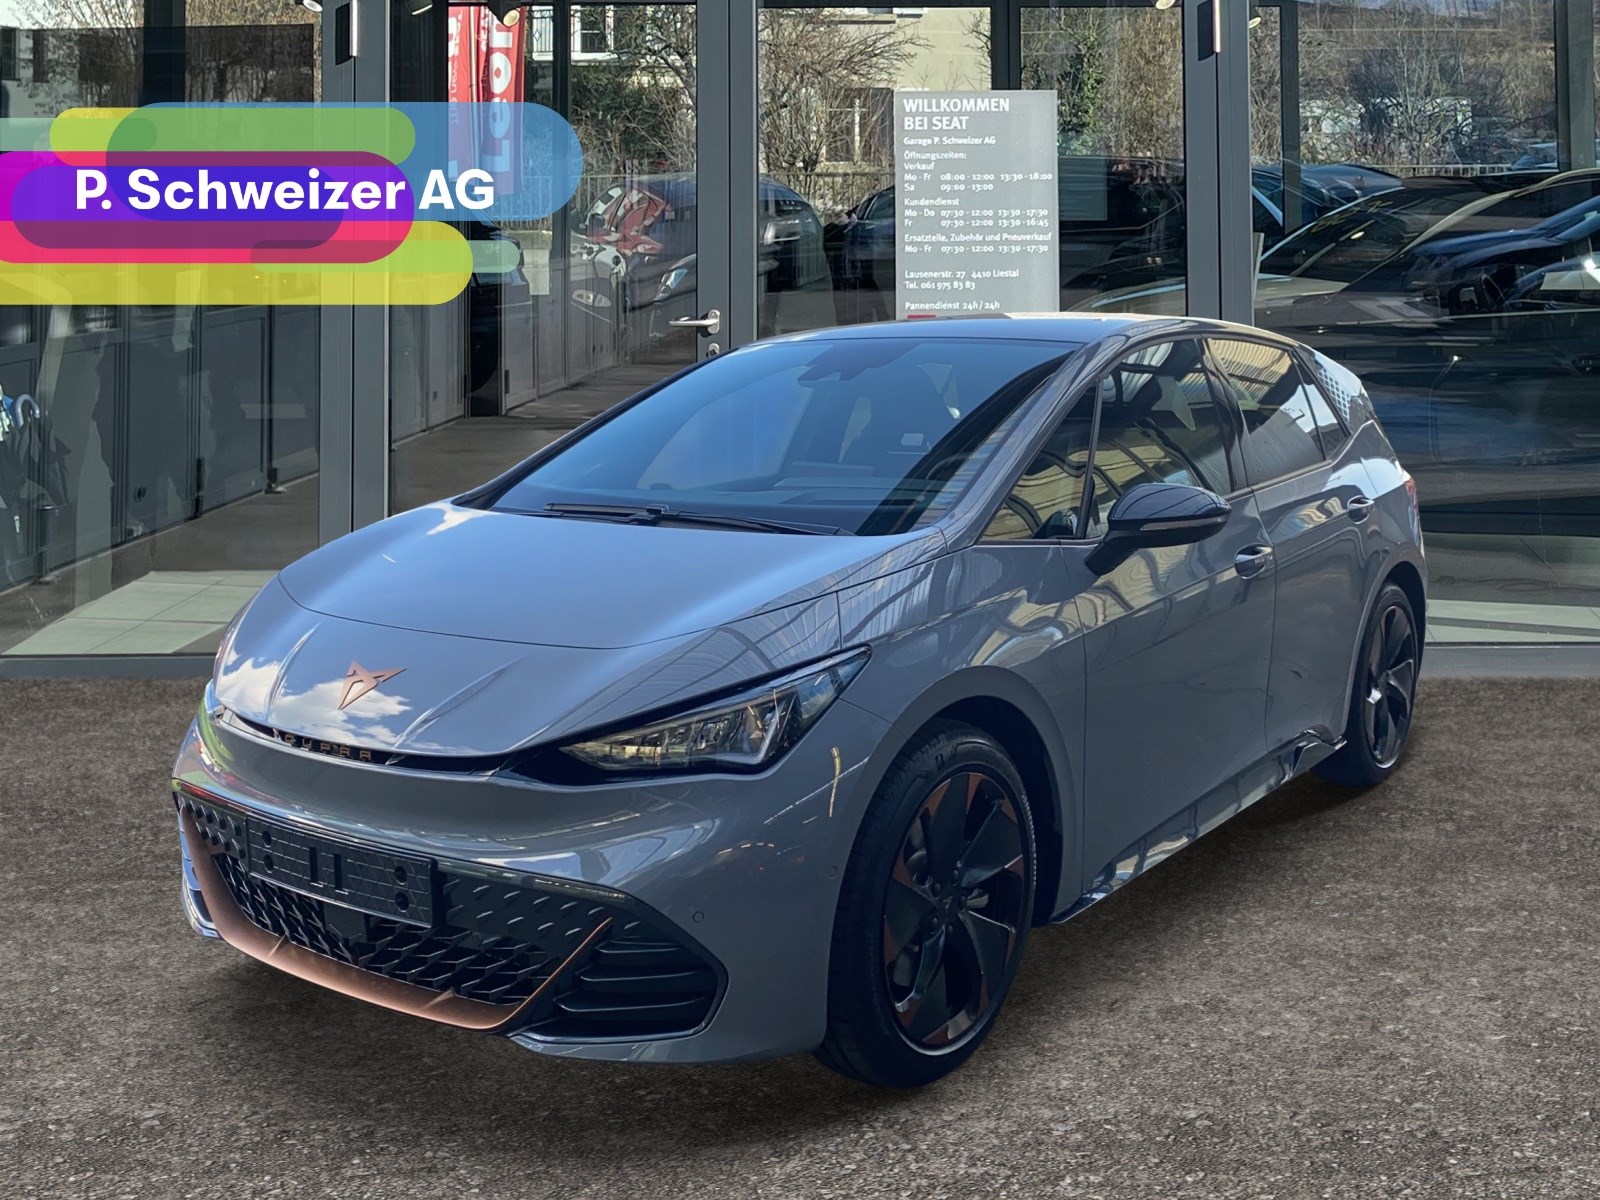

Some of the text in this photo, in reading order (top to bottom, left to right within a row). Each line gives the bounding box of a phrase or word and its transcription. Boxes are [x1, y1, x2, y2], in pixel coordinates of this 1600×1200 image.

[903, 98, 1010, 113] WILLKOMMEN
[903, 116, 969, 131] BEI SEAT
[903, 136, 997, 146] Garage P. Schweizer AG
[903, 150, 967, 161] Öffnungszeiten:
[903, 162, 935, 171] Verkauf
[904, 173, 917, 181] Mo
[923, 173, 932, 181] Fr
[940, 173, 966, 181] 08:00
[972, 173, 995, 181] 12:00
[1000, 173, 1023, 182] 13:30
[1029, 172, 1053, 180] 18:00
[904, 183, 915, 192] Sa
[940, 184, 965, 193] 09:00
[971, 183, 994, 192] 13:00
[904, 197, 960, 206] Kundendienst
[904, 209, 918, 217] Mo
[923, 209, 935, 217] Do
[940, 209, 964, 219] 07:30
[998, 209, 1021, 218] 13:30
[1026, 209, 1048, 218] 17:30
[904, 219, 913, 227] Fr
[940, 219, 964, 228] 07:30
[998, 219, 1021, 228] 13:30
[1026, 218, 1049, 227] 16:45
[904, 232, 1053, 243] Ersatzteile, Zubehör und Pneuverkauf
[904, 245, 918, 253] Mo
[940, 245, 964, 254] 07:30
[971, 245, 994, 253] 12:00
[998, 245, 1021, 253] 13:30
[1026, 245, 1049, 253] 17:30
[905, 269, 1019, 279] Lausenerstr. 27 4410 Liestal
[904, 280, 976, 290] Tel. 061 975 83 83
[905, 301, 960, 310] Pannendienst
[962, 301, 979, 310] 24h
[984, 301, 1001, 310] 24h
